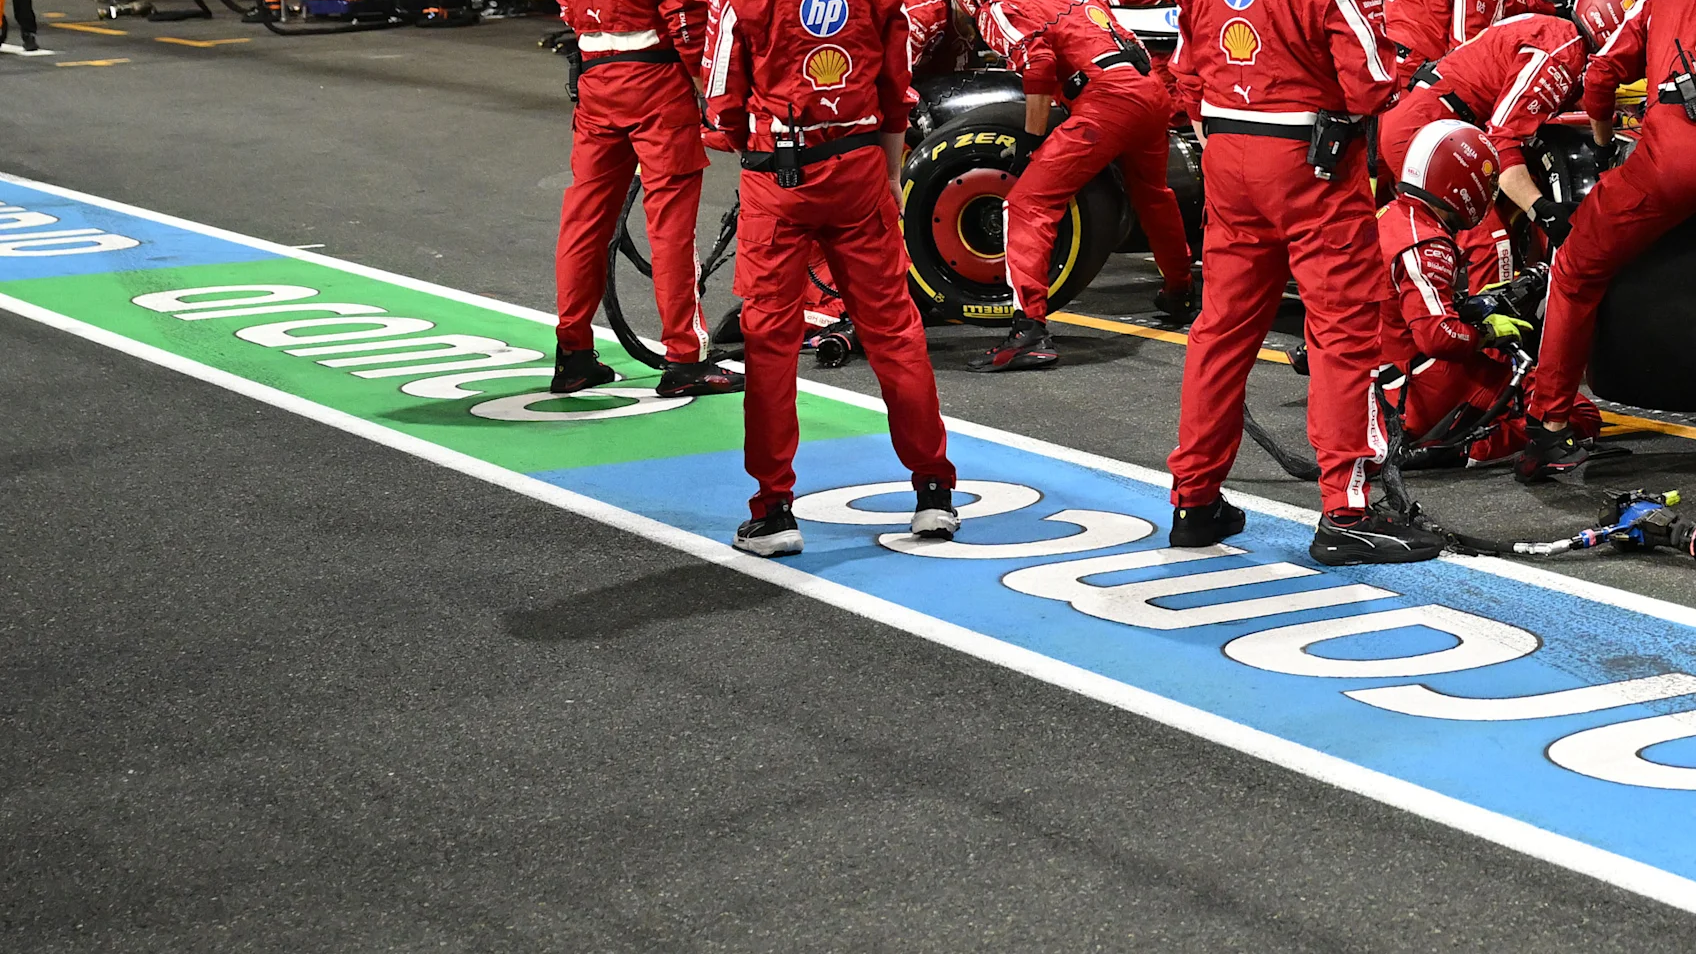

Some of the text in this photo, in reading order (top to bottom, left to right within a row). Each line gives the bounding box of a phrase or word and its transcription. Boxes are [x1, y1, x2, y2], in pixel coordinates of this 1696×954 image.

[1547, 65, 1569, 94] CEVA
[931, 132, 1018, 162] P ZER
[1500, 248, 1511, 283] SCUD
[963, 304, 1014, 315] IRELLI
